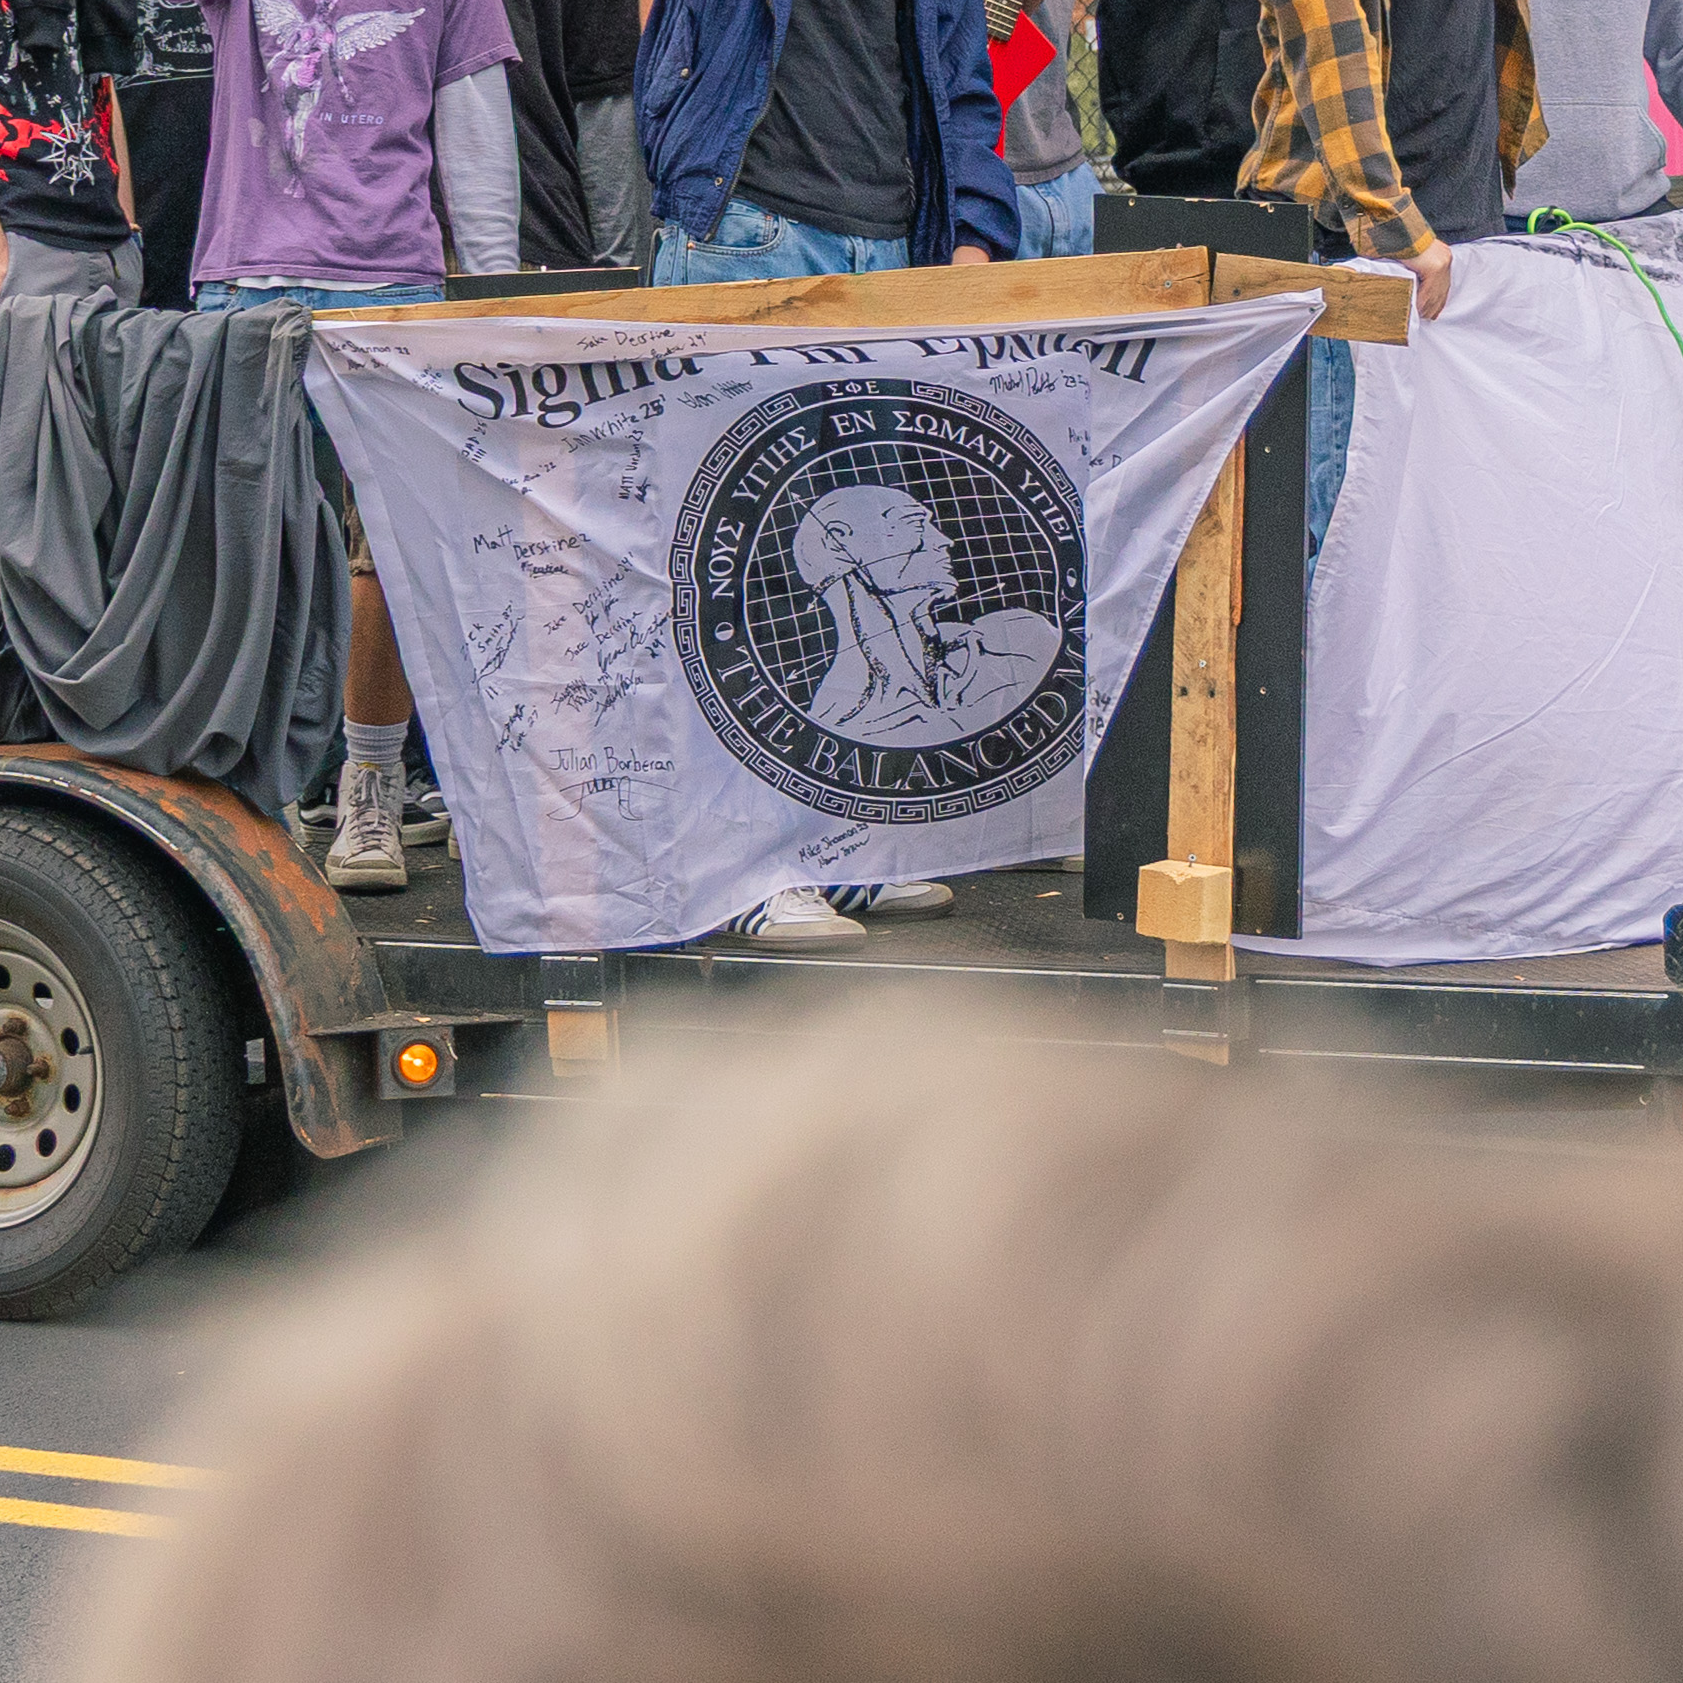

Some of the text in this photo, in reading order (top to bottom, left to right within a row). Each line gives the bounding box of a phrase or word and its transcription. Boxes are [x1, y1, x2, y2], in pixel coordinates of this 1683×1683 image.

[318, 113, 385, 126] IN UTERO
[591, 411, 640, 440] White
[472, 524, 514, 555] Matt
[512, 535, 579, 561] Derstine
[717, 644, 807, 755] THE
[803, 690, 1068, 791] BALANCED
[548, 747, 598, 771] Julian
